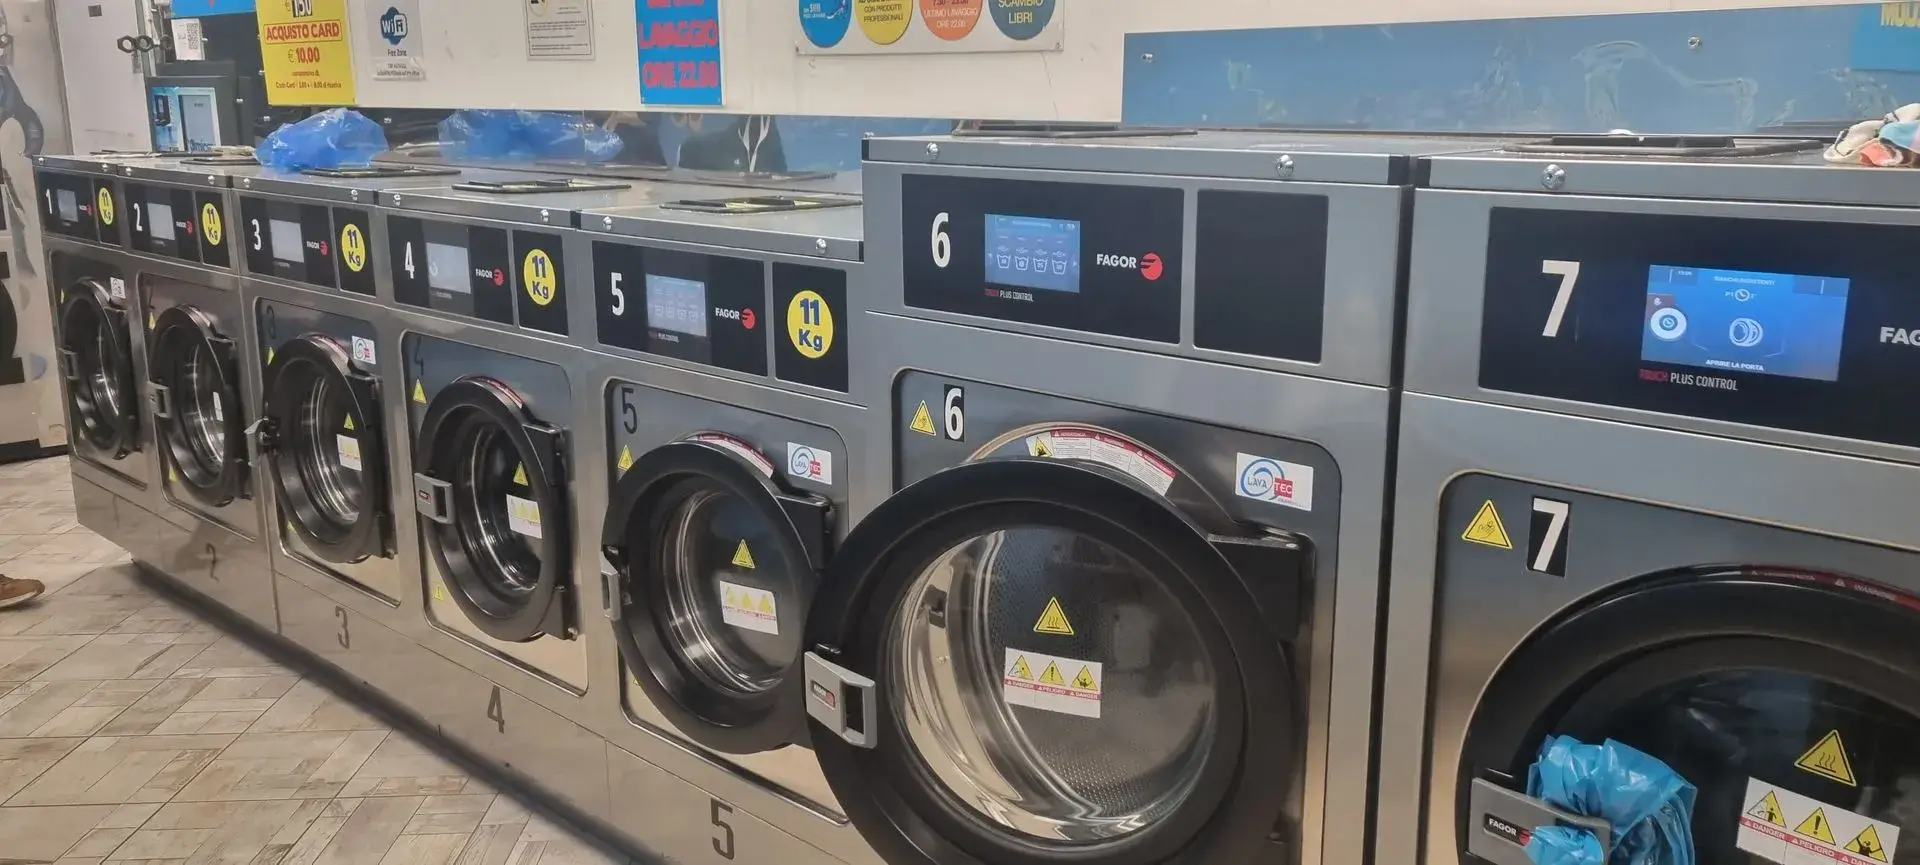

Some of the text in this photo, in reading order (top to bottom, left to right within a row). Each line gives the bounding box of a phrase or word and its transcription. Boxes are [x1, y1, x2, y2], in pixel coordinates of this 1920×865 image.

[876, 4, 902, 12] PRODOTTI
[924, 8, 977, 17] ULTIMO LAVAGGIO
[382, 19, 403, 33] WiFi
[864, 14, 903, 22] PROFESSIONALI
[1008, 12, 1033, 24] LIBRI
[266, 22, 340, 41] ACQUISTO CARD
[639, 19, 717, 48] LAVAGGIO
[296, 47, 320, 64] 10,00
[643, 61, 676, 87] ORE
[45, 189, 52, 214] 1
[101, 191, 109, 206] 11
[103, 210, 111, 221] Kg
[133, 203, 143, 232] 2
[206, 208, 216, 225] 11
[208, 227, 218, 240] Kg
[252, 218, 261, 250] 3
[347, 229, 358, 249] 11
[931, 212, 951, 268] 6
[348, 251, 361, 266] Kg
[405, 241, 415, 279] 4
[532, 255, 547, 278] 11
[1096, 253, 1137, 269] FAGOR
[475, 268, 493, 279] FAGOR
[532, 281, 549, 300] Kg
[610, 272, 625, 316] 5
[1000, 290, 1012, 299] PLUS
[1542, 259, 1580, 337] 7
[715, 307, 740, 320] FAGOR
[800, 298, 820, 326] 11
[798, 328, 823, 352] Kg
[414, 336, 424, 375] 4
[1705, 359, 1764, 372] APRIRE LA PORTA
[1670, 372, 1694, 386] PLUS
[1696, 375, 1738, 391] CONTROL
[621, 386, 638, 434] 5
[945, 387, 963, 440] 6
[1247, 476, 1293, 494] LAVA TEC
[1532, 497, 1569, 572] 7
[335, 605, 350, 649] 3
[1012, 681, 1034, 689] DANGER
[1042, 686, 1066, 695] PELIGRO
[487, 685, 505, 734] 4
[711, 798, 735, 860] 5
[1489, 818, 1517, 836] FAGOR
[1752, 822, 1785, 840] DANGER
[1798, 837, 1835, 857] PELIGRO
